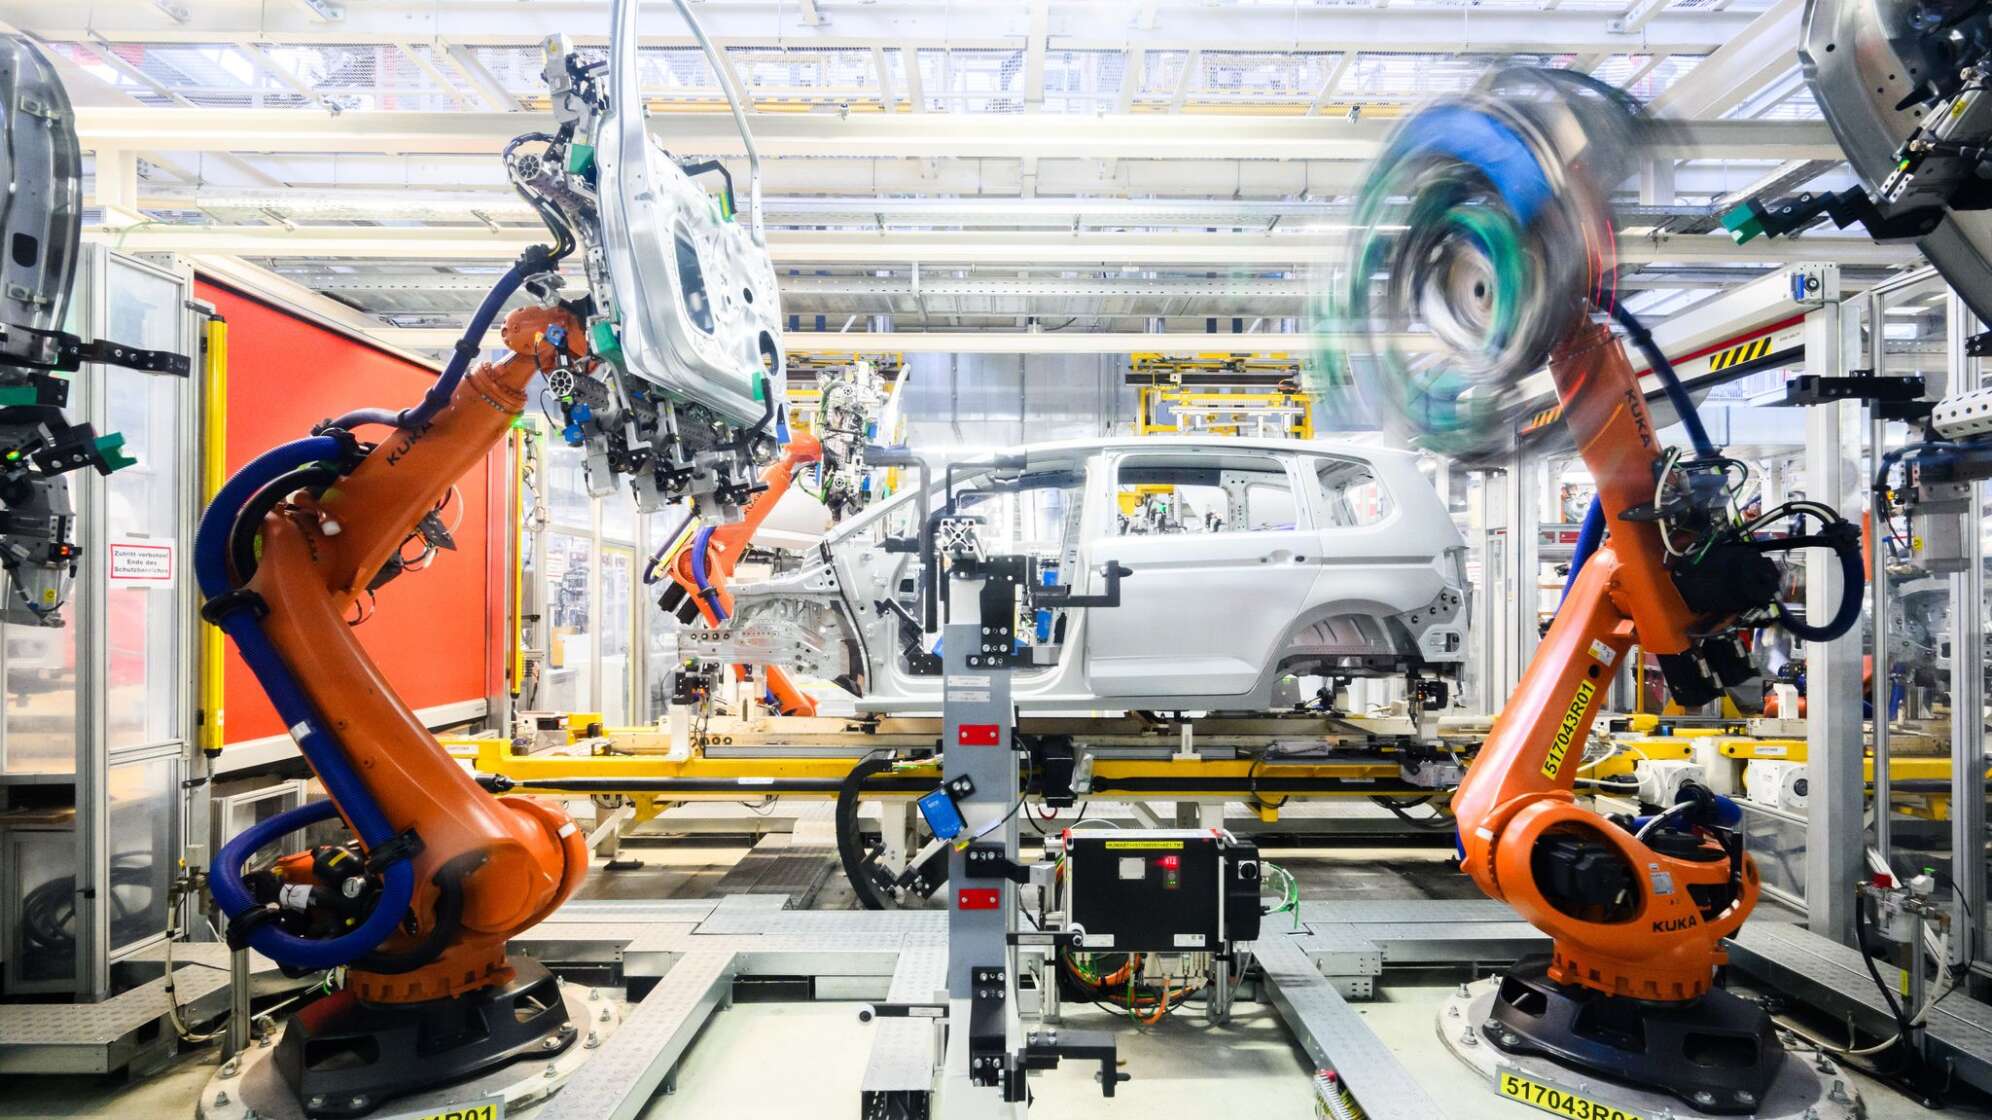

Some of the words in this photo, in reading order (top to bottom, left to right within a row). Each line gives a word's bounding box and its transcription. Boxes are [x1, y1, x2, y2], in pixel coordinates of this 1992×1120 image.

[1624, 388, 1652, 449] KUKA
[1543, 682, 1594, 775] 517043R01
[1652, 914, 1697, 933] KUKA
[1506, 1076, 1640, 1120] 517043R
